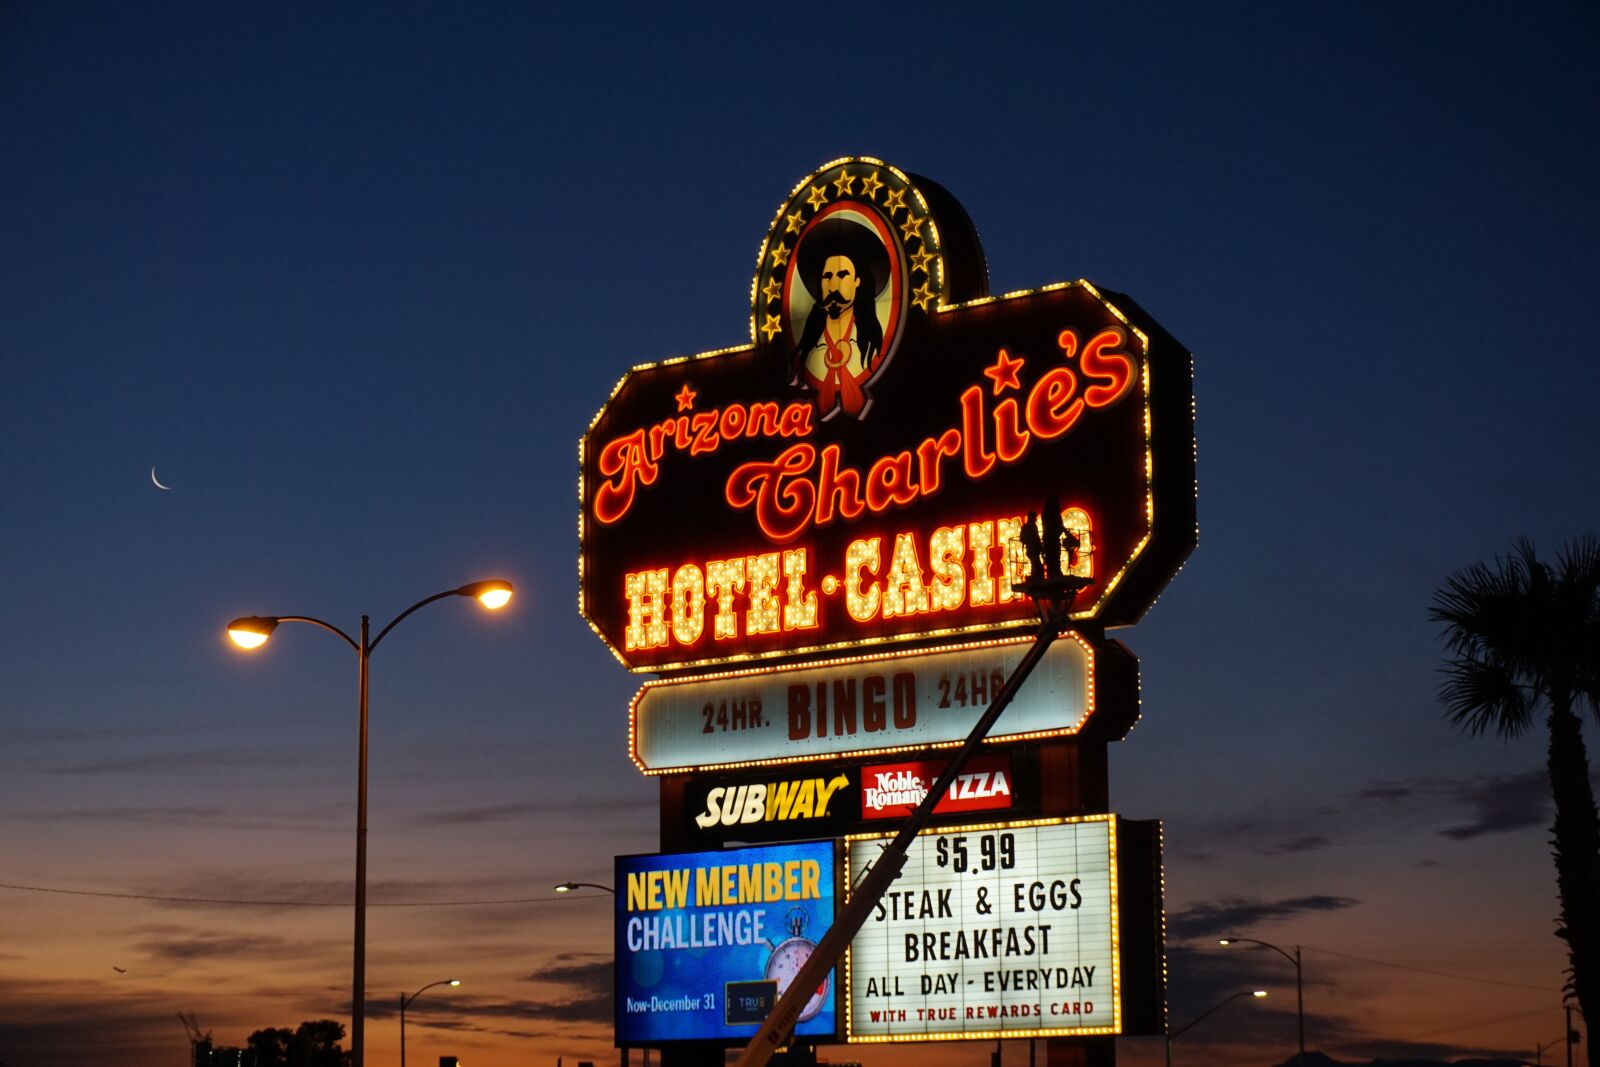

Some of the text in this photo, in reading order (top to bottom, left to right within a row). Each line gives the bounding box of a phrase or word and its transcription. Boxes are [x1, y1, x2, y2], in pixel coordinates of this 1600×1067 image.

[594, 384, 813, 524] Arizona
[725, 330, 1134, 542] Charlie's
[624, 548, 819, 651] HOTEL
[702, 699, 770, 735] 24HR.
[788, 672, 917, 741] BINGO
[695, 772, 850, 830] SUBWAY
[864, 787, 929, 811] Roman's
[875, 770, 921, 793] Noble
[932, 771, 1010, 800] IZZA
[936, 833, 1016, 876] $5.99
[627, 860, 821, 912] NEW MEMBER
[875, 878, 1083, 922] STEAK & EGGS
[627, 910, 767, 951] CHALLENGE
[905, 925, 1052, 963] BREAKFAST
[703, 994, 716, 1010] 31
[865, 976, 905, 998] ALL
[921, 973, 959, 996] DAY
[984, 966, 1096, 993] EVERYDAY
[869, 1001, 1094, 1023] WITH TRUE REWARDS CARD
